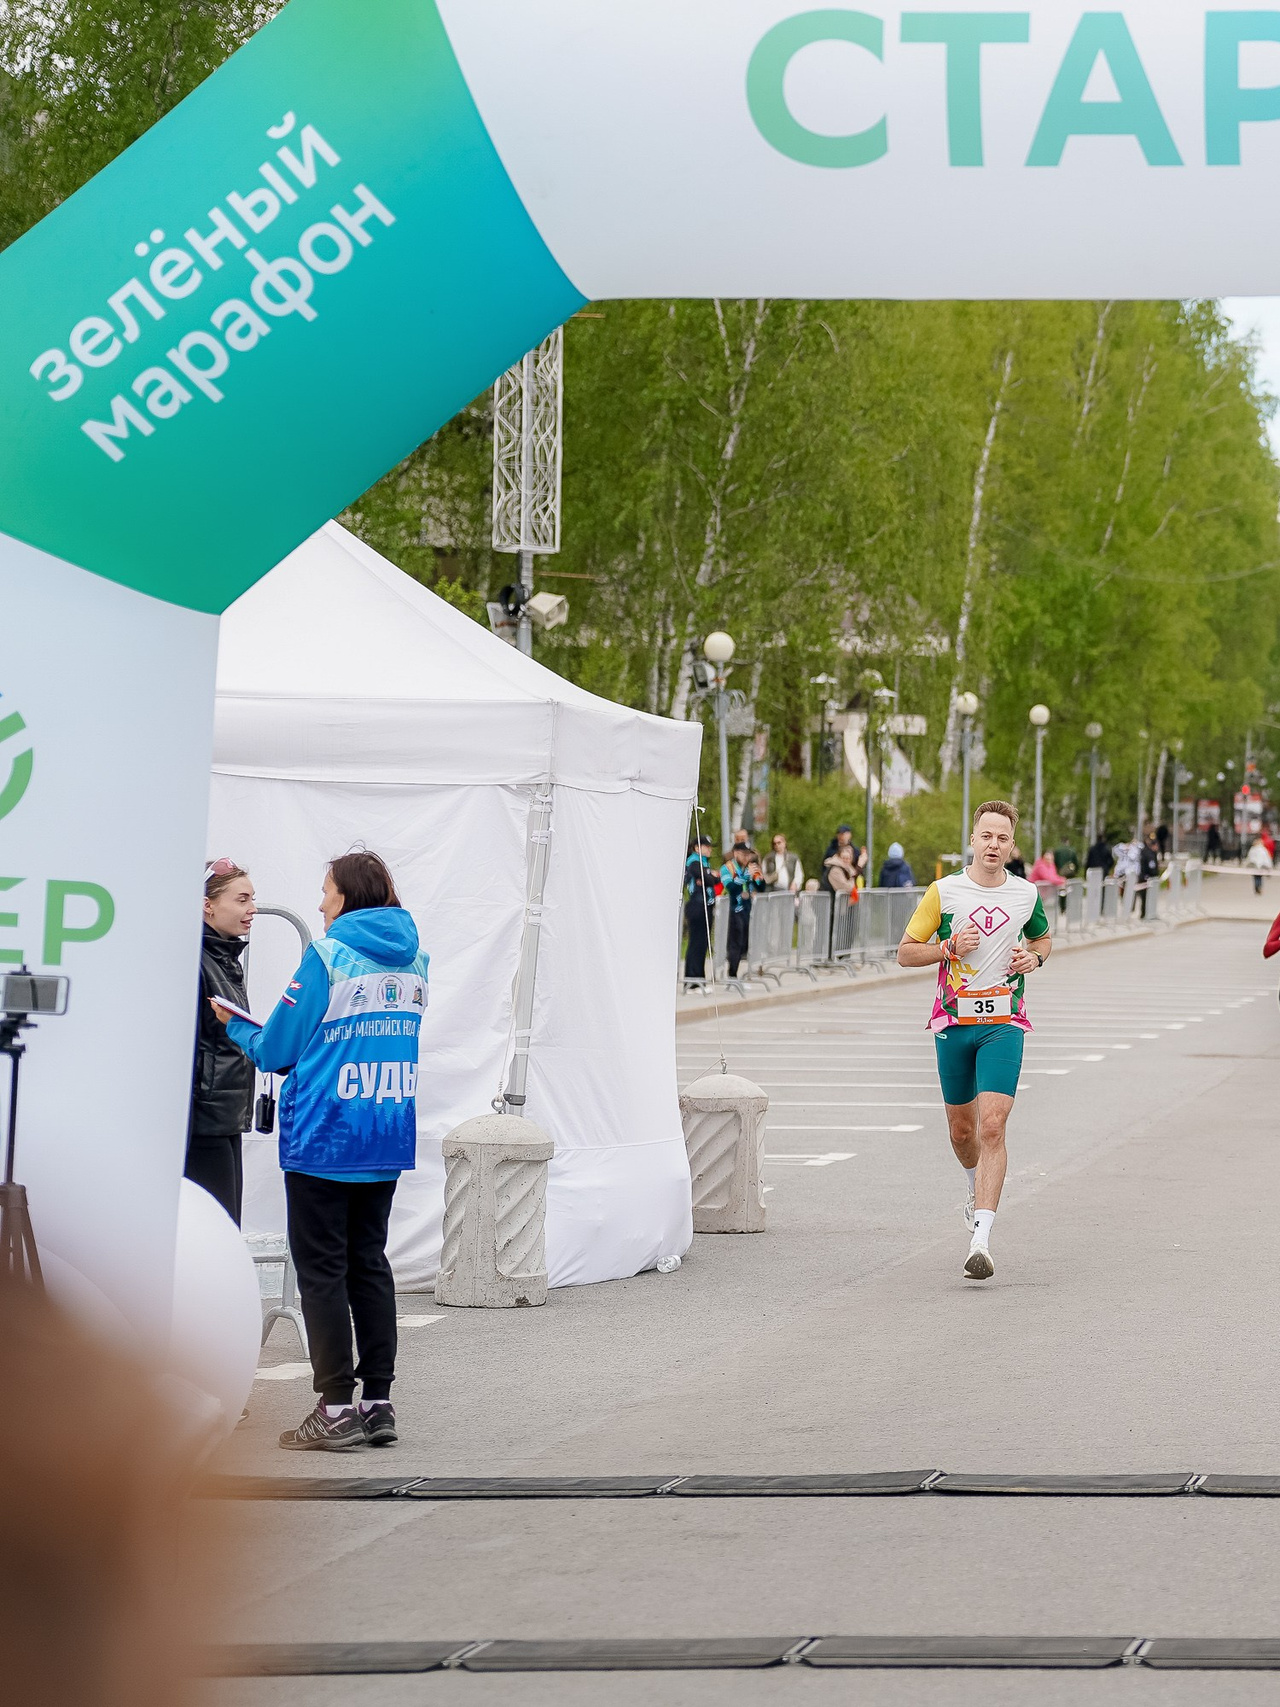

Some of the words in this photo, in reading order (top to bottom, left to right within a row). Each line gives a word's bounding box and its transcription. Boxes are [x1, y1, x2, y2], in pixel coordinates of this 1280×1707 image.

[29, 111, 342, 402] зелёный
[80, 183, 397, 463] марафон
[323, 1016, 401, 1044] ХАНТЫ-МАНСИЙСК
[974, 1000, 995, 1014] 35
